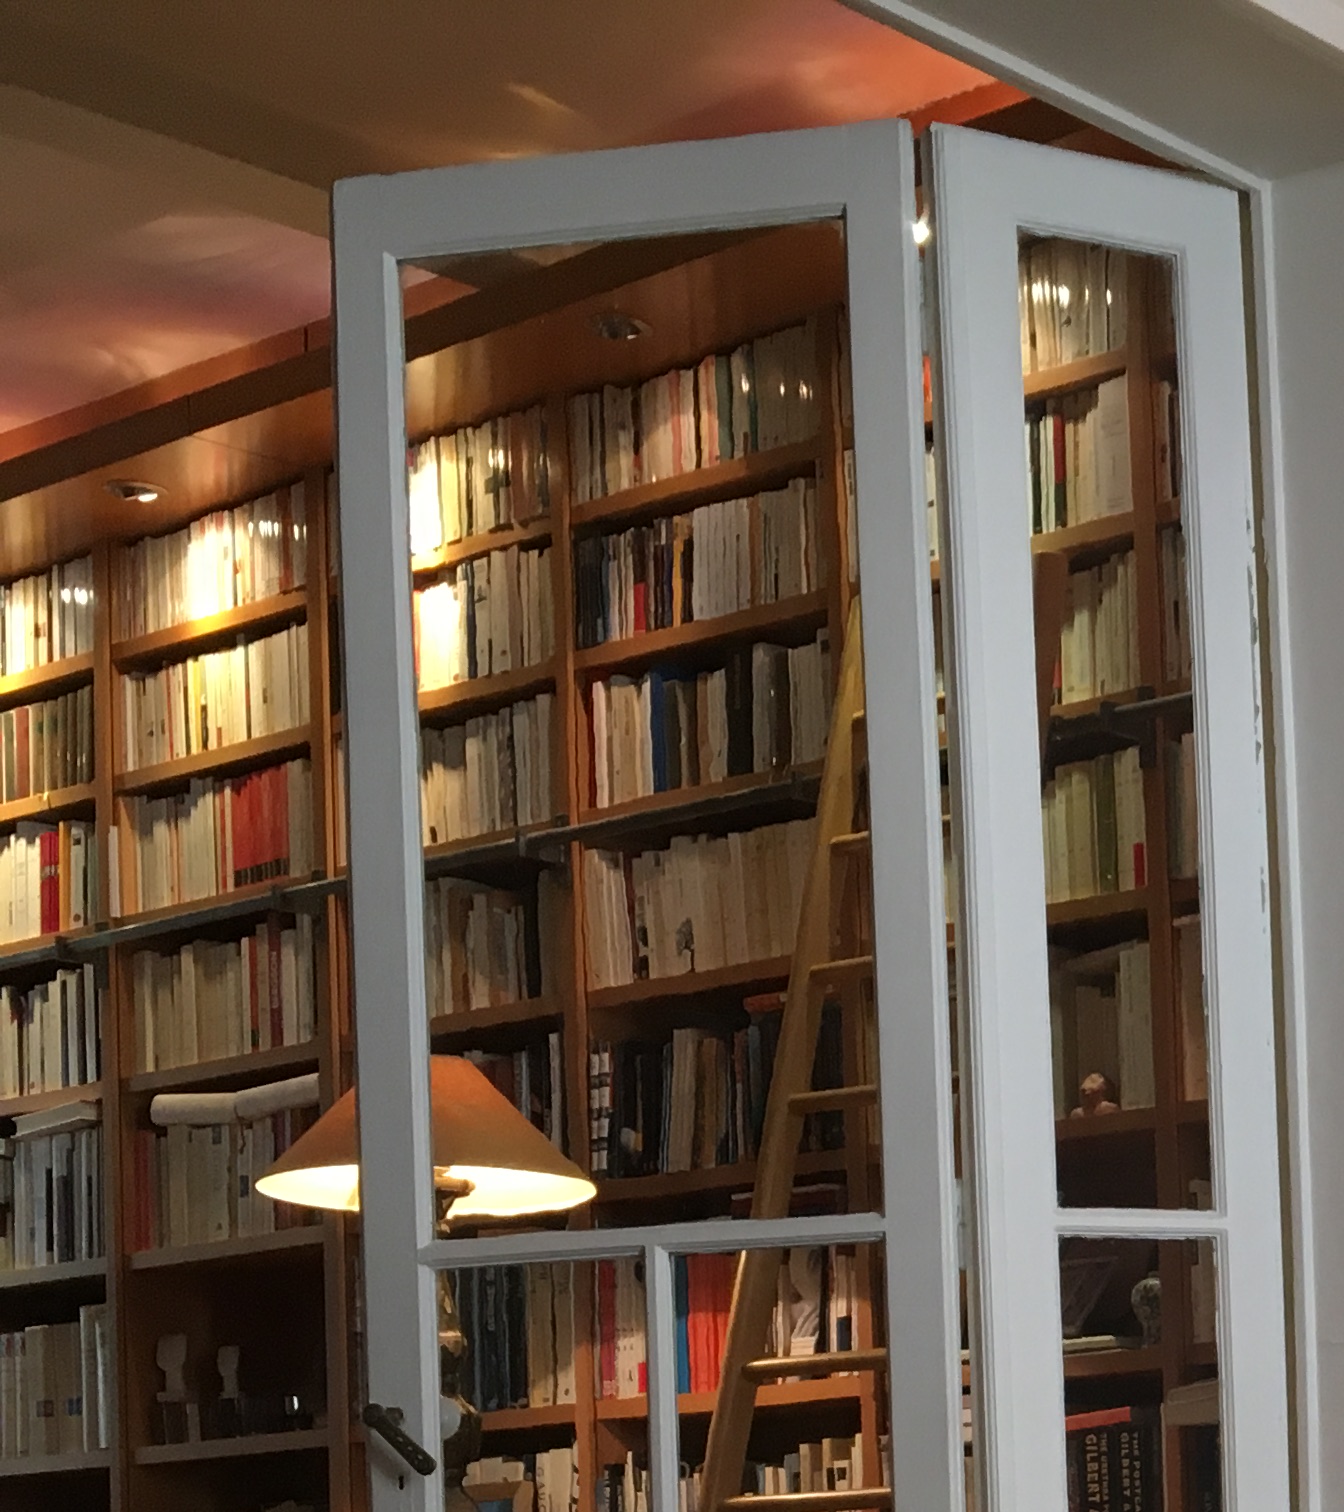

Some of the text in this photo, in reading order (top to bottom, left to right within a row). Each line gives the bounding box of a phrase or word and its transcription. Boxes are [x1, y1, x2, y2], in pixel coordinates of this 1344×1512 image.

[1100, 1434, 1108, 1452] THE
[1120, 1432, 1131, 1496] GILBERT
[1132, 1432, 1140, 1456] THE
[1085, 1434, 1100, 1503] GILBERT
